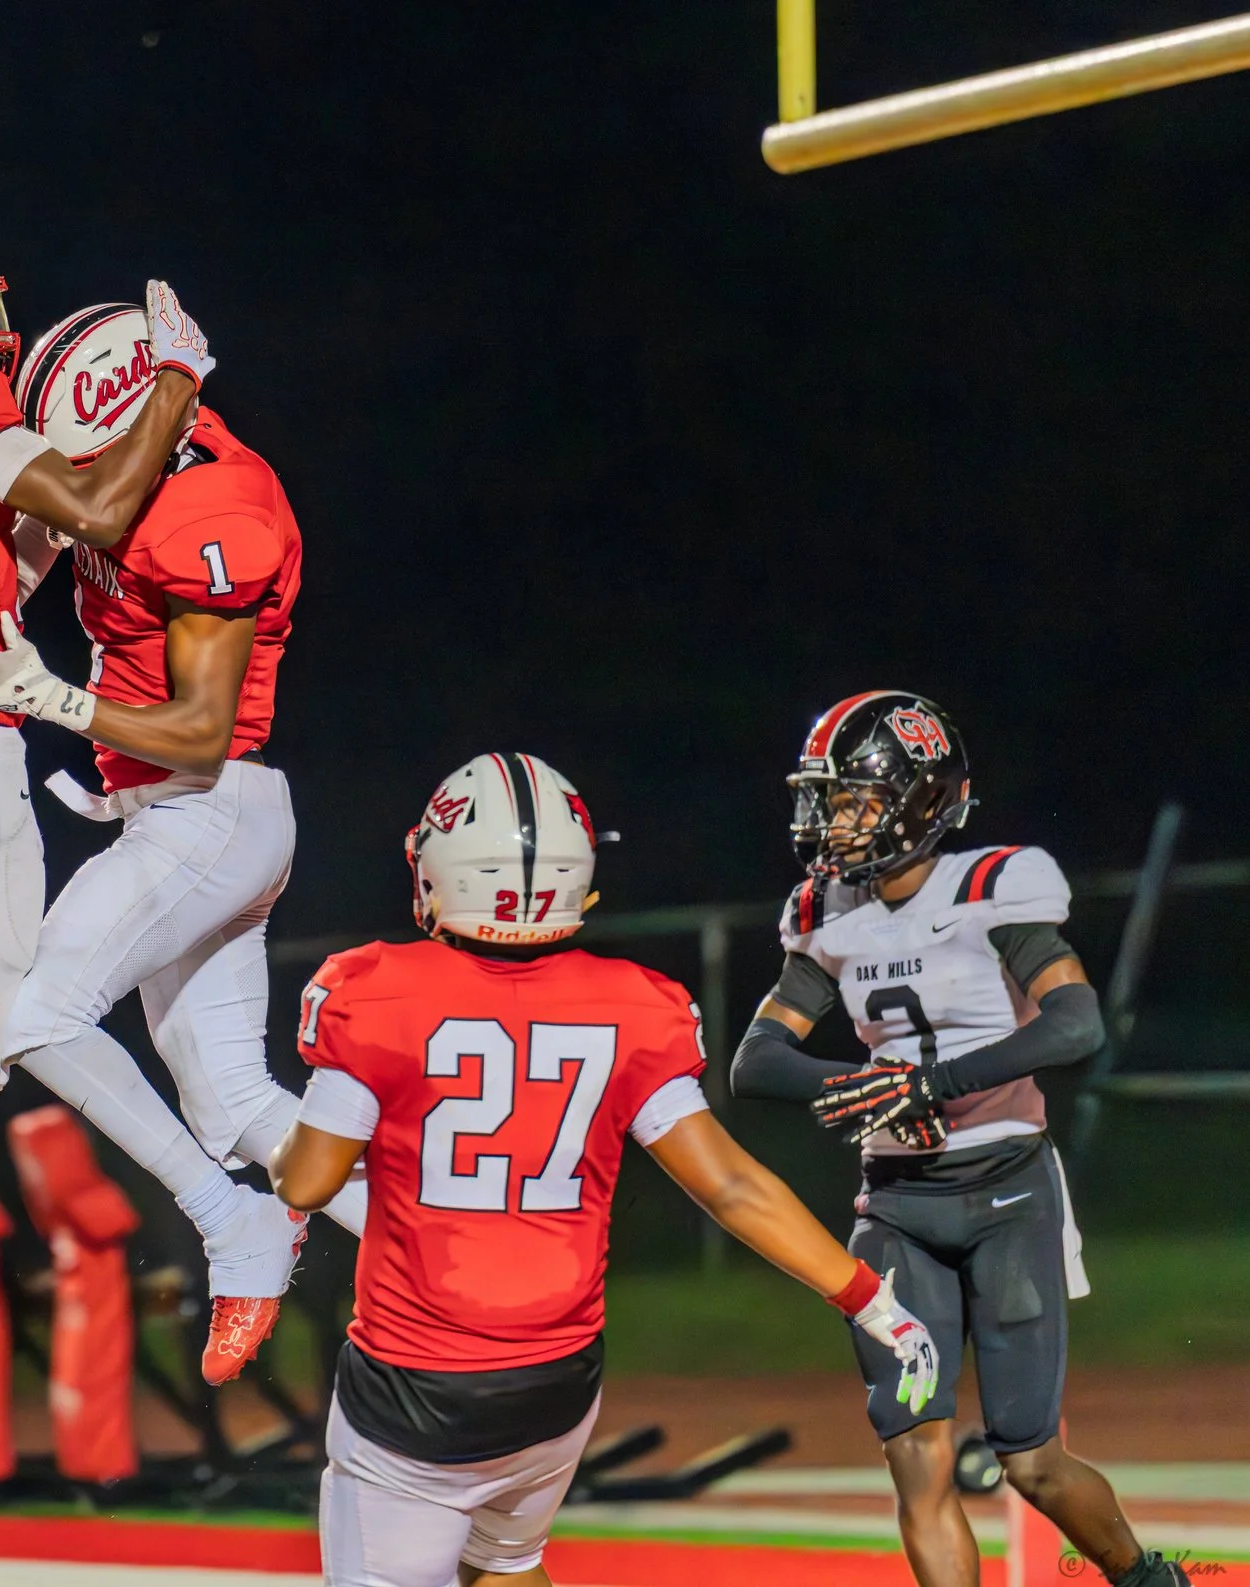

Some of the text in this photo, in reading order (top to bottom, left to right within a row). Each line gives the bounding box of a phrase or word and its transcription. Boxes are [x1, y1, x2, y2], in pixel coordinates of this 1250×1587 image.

[200, 541, 234, 597] 1
[494, 889, 556, 923] 27
[478, 925, 564, 943] Riddell
[856, 957, 923, 982] OAK HILLS
[417, 1017, 619, 1213] 27
